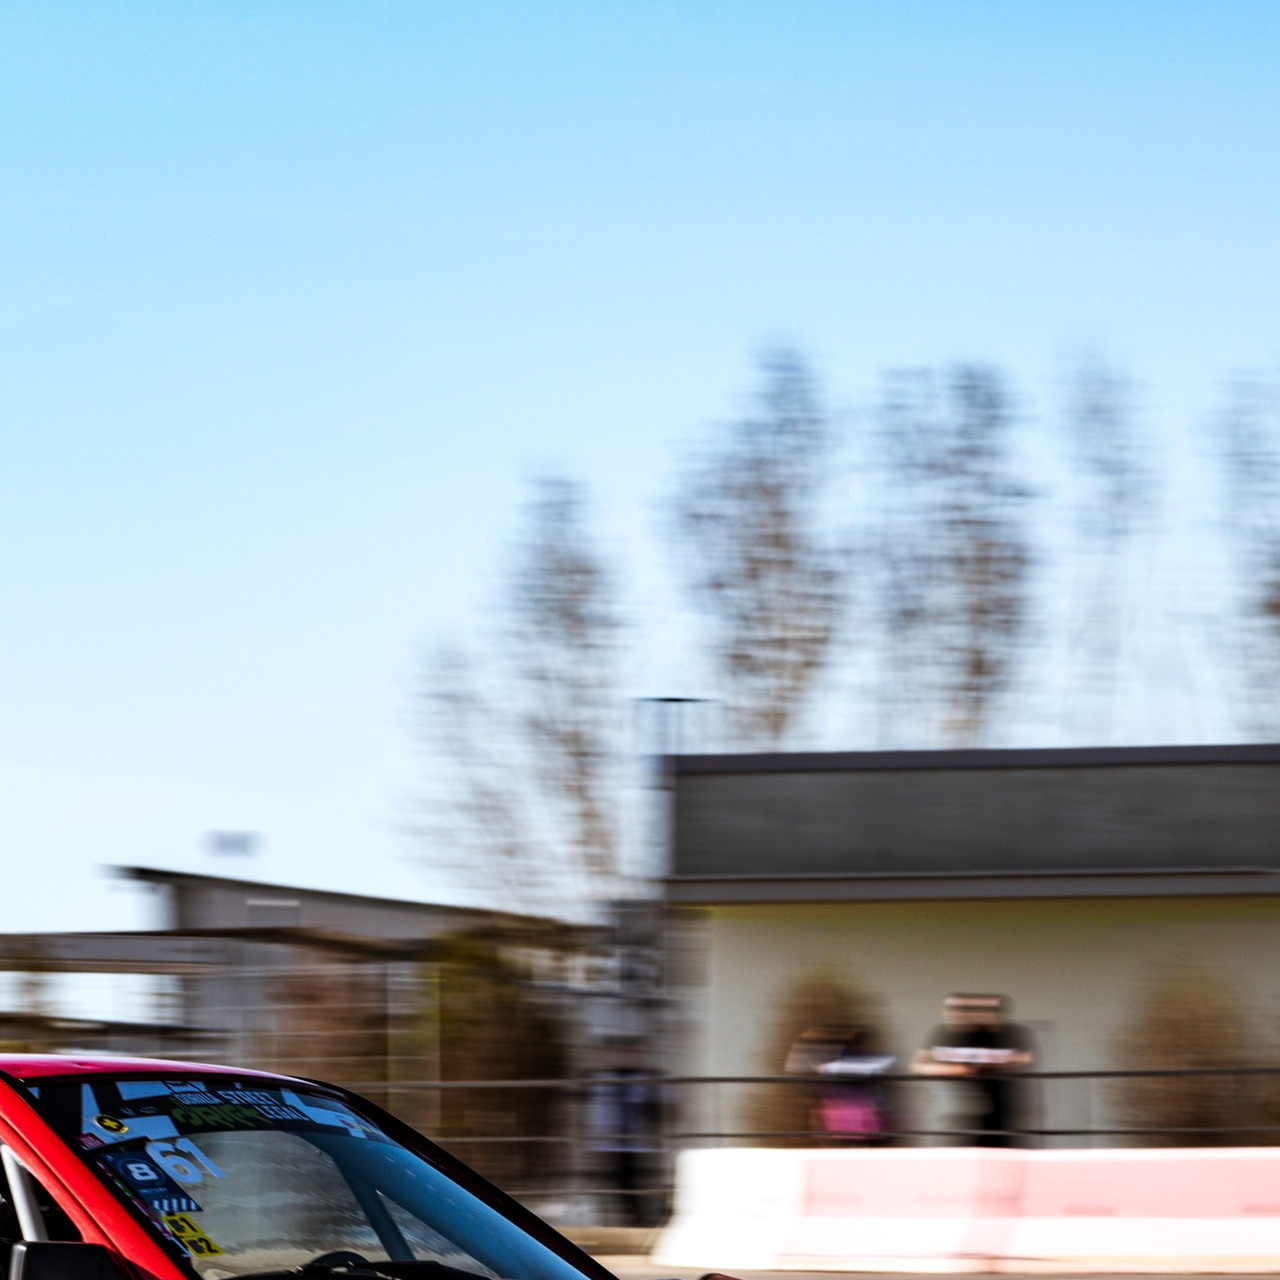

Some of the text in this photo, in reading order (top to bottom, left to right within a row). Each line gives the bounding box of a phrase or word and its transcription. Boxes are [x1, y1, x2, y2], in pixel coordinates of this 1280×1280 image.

[216, 1090, 282, 1105] STREET
[253, 1105, 312, 1121] LEGAL
[145, 1132, 226, 1184] 61
